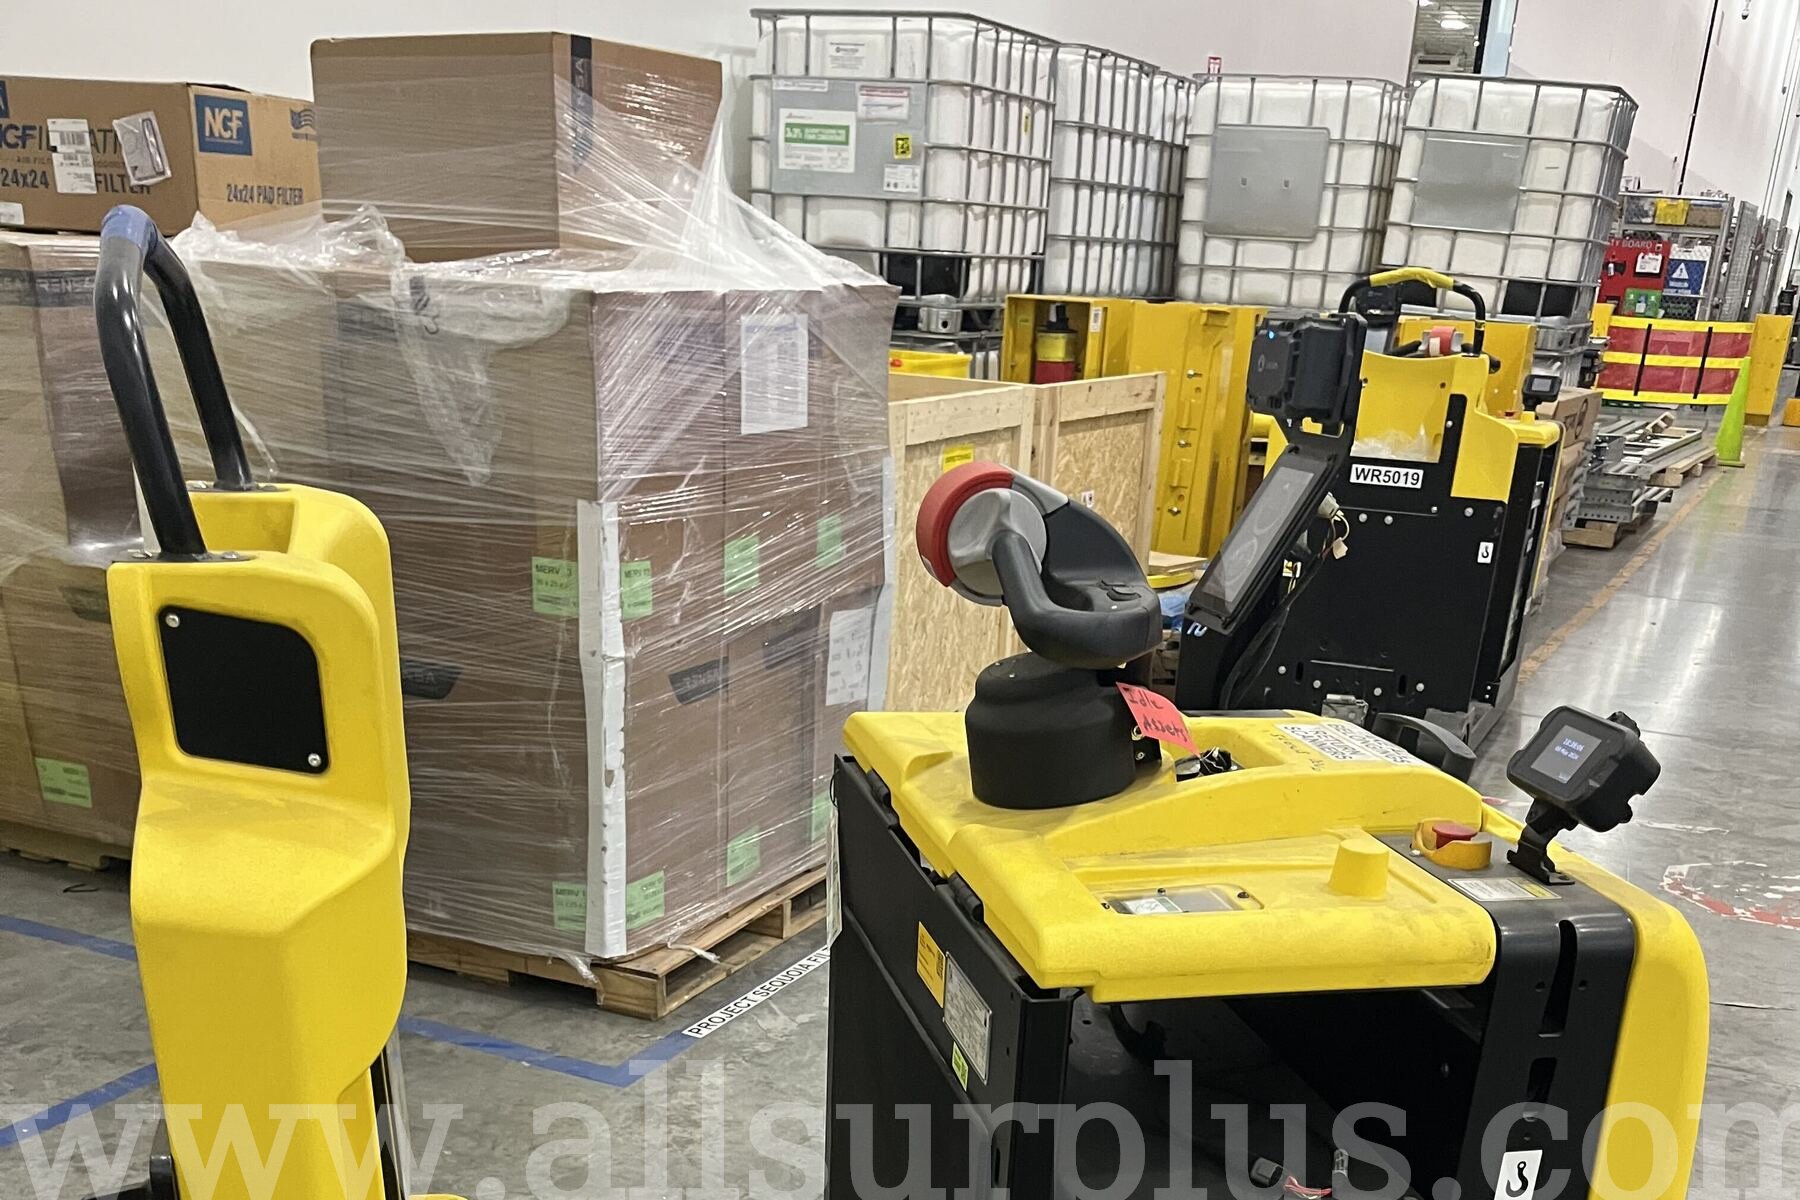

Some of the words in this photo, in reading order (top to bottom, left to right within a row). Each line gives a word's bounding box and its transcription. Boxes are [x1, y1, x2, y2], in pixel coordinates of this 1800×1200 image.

[204, 106, 244, 139] NCF
[1, 167, 50, 189] 24x24
[1355, 466, 1421, 486] WR5019
[535, 564, 560, 575] MERV
[1122, 686, 1165, 710] Idle
[1284, 726, 1353, 760] SCANNERS
[688, 996, 756, 1035] PROJECT
[752, 962, 813, 998] SEQUOIA
